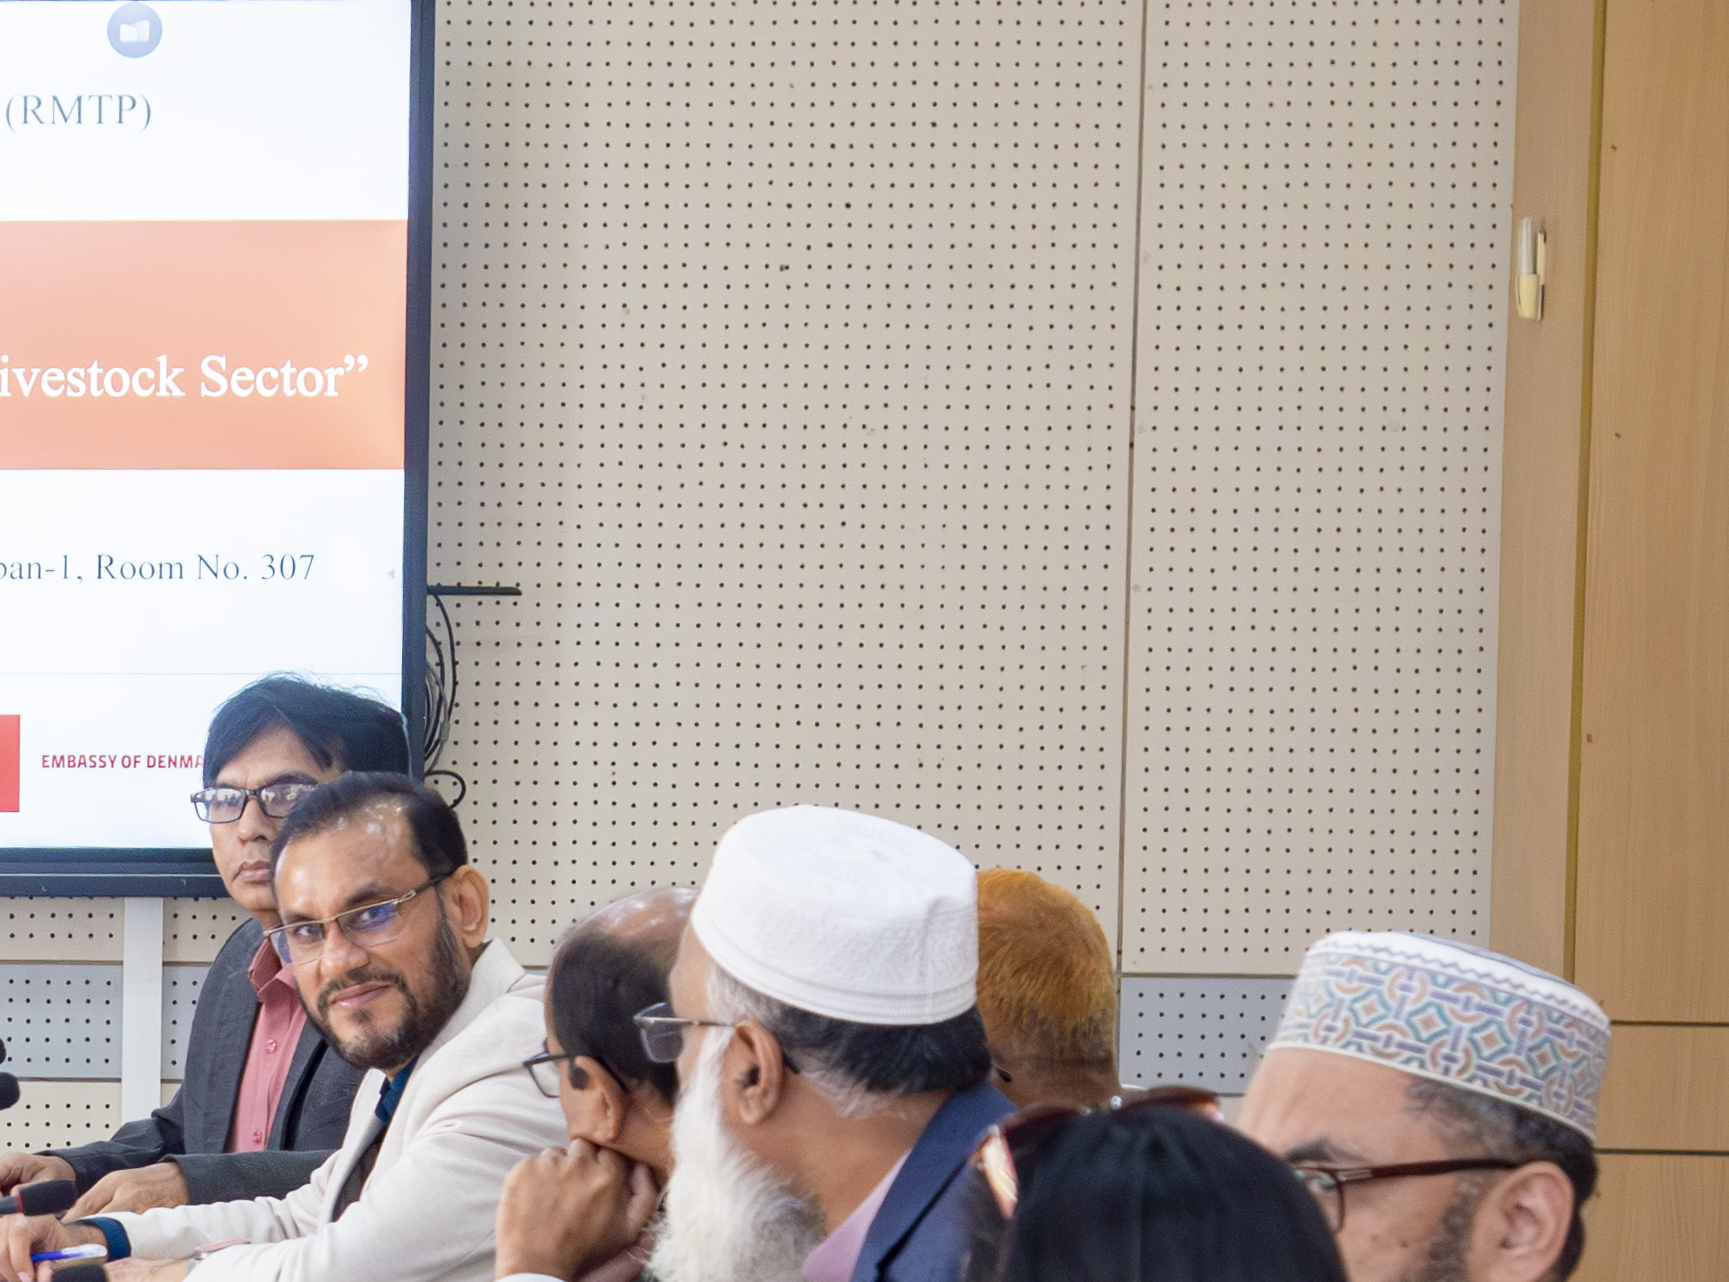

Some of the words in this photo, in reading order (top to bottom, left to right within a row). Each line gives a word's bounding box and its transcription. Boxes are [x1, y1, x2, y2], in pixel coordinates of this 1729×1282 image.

[5, 94, 154, 133] (RMTP)
[200, 354, 371, 399] Sector”
[95, 554, 185, 582] Room
[197, 554, 250, 582] No.
[260, 554, 316, 582] 307
[42, 755, 117, 769] EMBASSY
[121, 755, 141, 769] OF
[147, 755, 204, 769] DENMA
